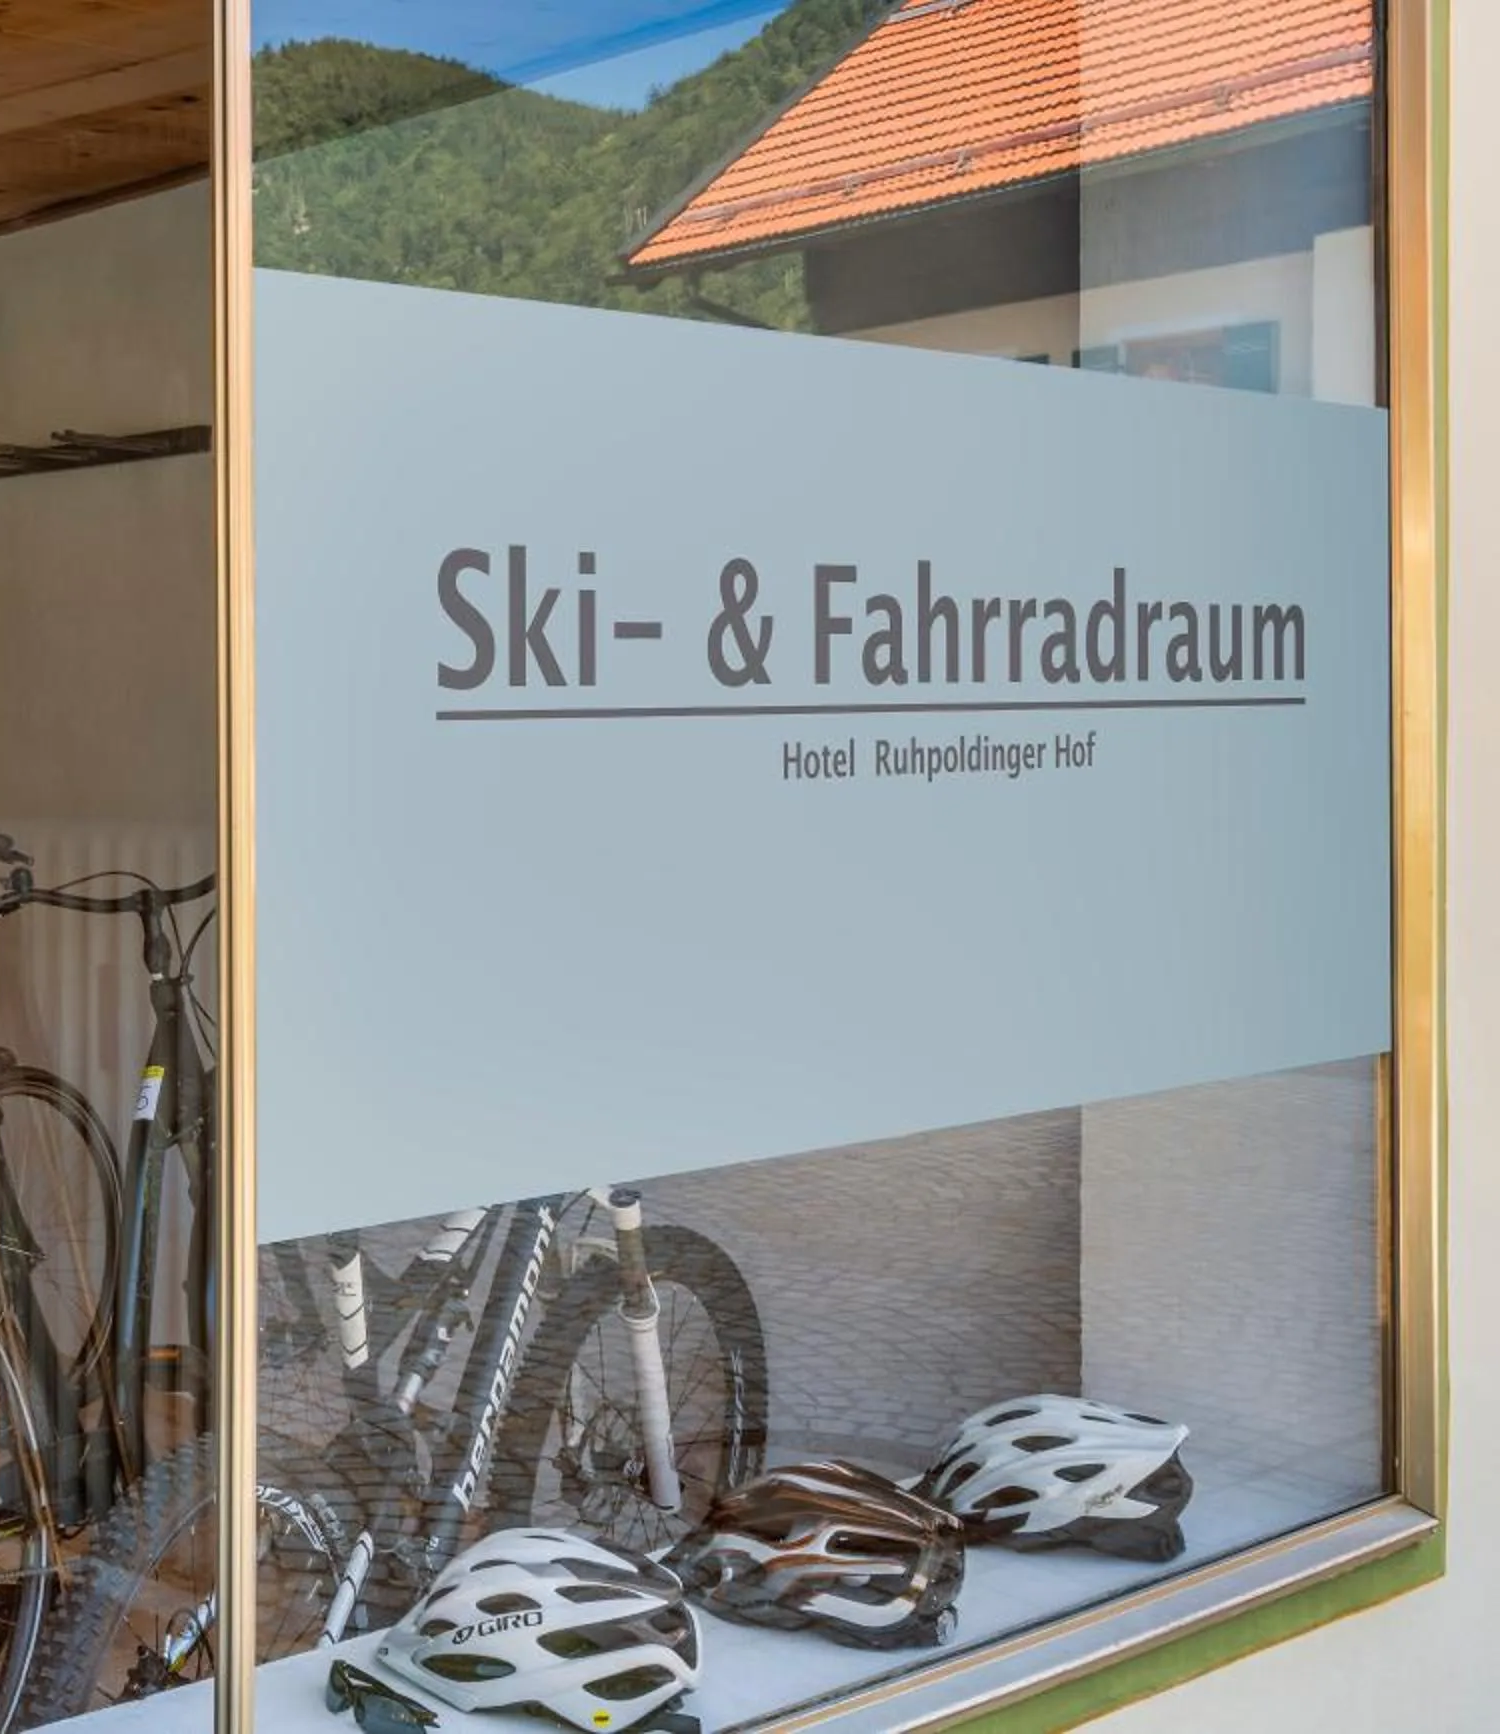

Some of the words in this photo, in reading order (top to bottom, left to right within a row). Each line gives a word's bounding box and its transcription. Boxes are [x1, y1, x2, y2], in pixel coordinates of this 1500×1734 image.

[436, 545, 663, 691] Ski-
[707, 557, 774, 688] &
[814, 559, 1306, 686] Fahrradraum
[783, 738, 856, 780] Hotel
[875, 735, 1047, 783] Ruhpoldinger
[1054, 731, 1098, 769] Hof
[452, 1205, 555, 1513] bergamont
[477, 1611, 543, 1637] GIRO
